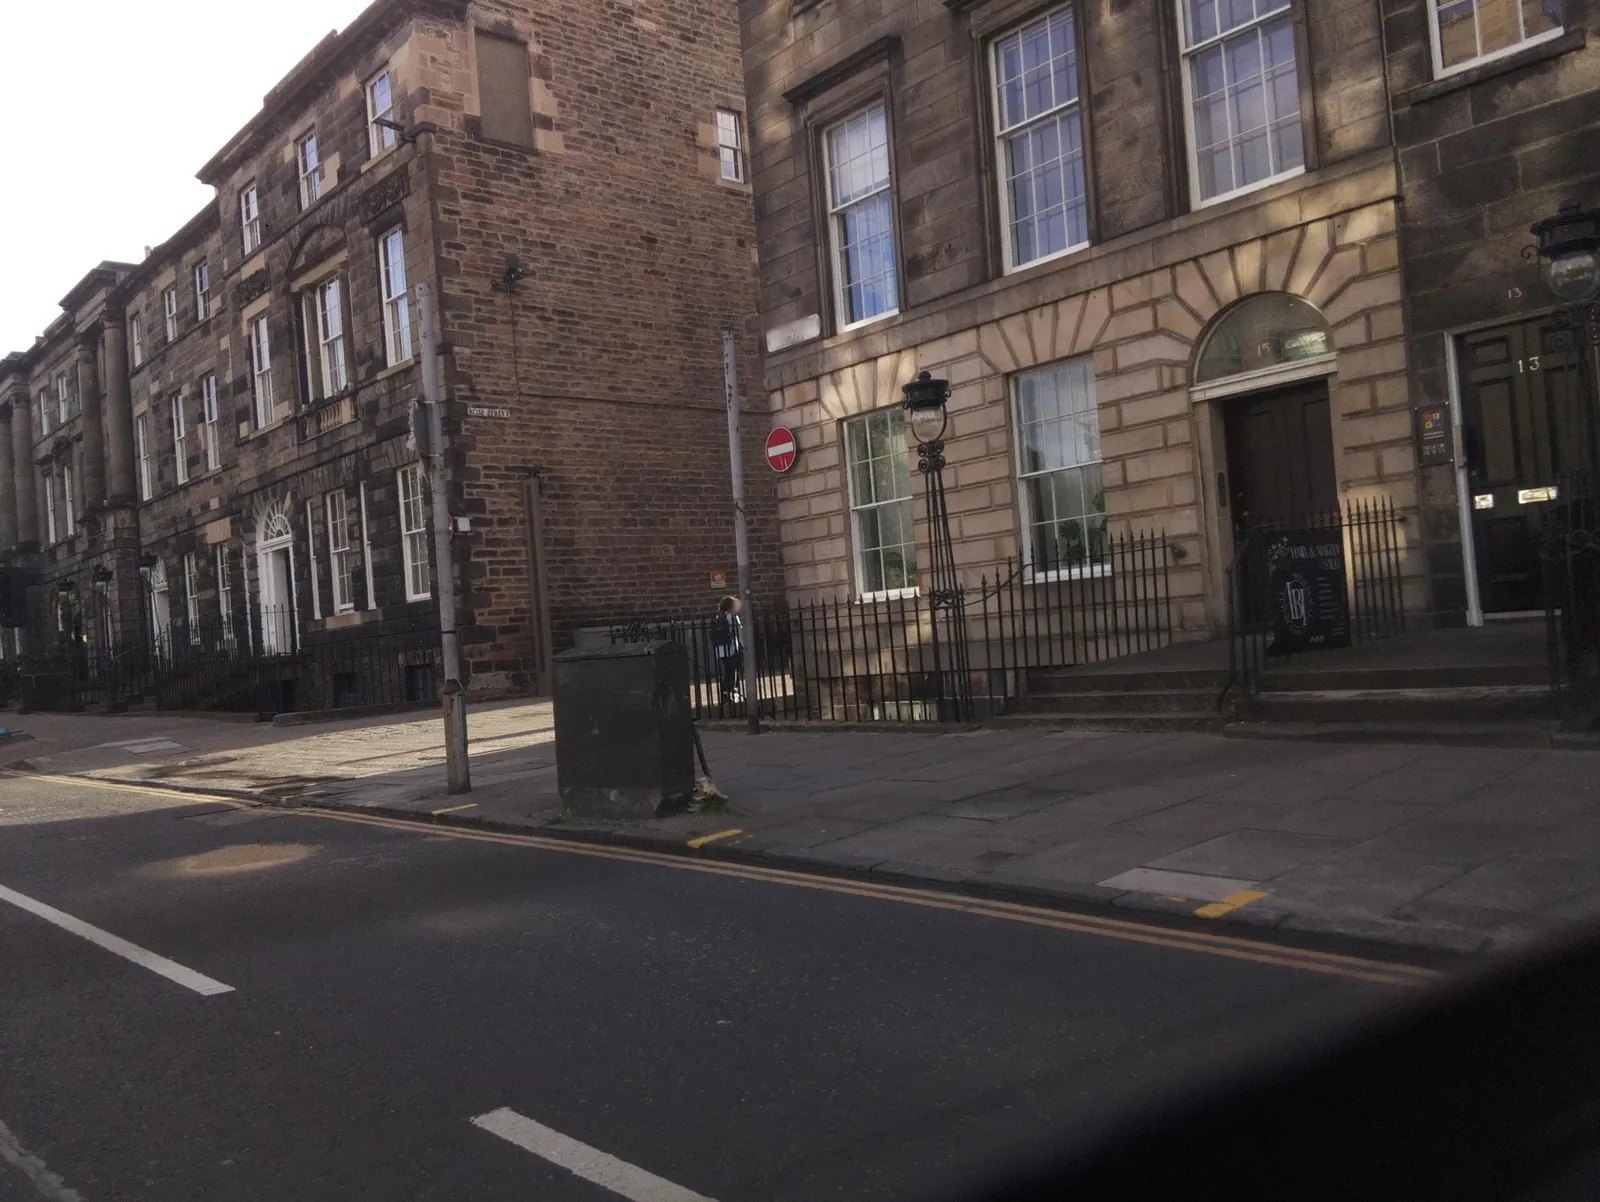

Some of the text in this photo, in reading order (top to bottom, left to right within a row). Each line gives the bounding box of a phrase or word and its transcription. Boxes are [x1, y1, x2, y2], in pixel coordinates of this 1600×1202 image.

[1508, 287, 1523, 299] 13
[1257, 342, 1270, 357] 15
[1517, 356, 1540, 373] 13
[469, 408, 485, 416] ROSE
